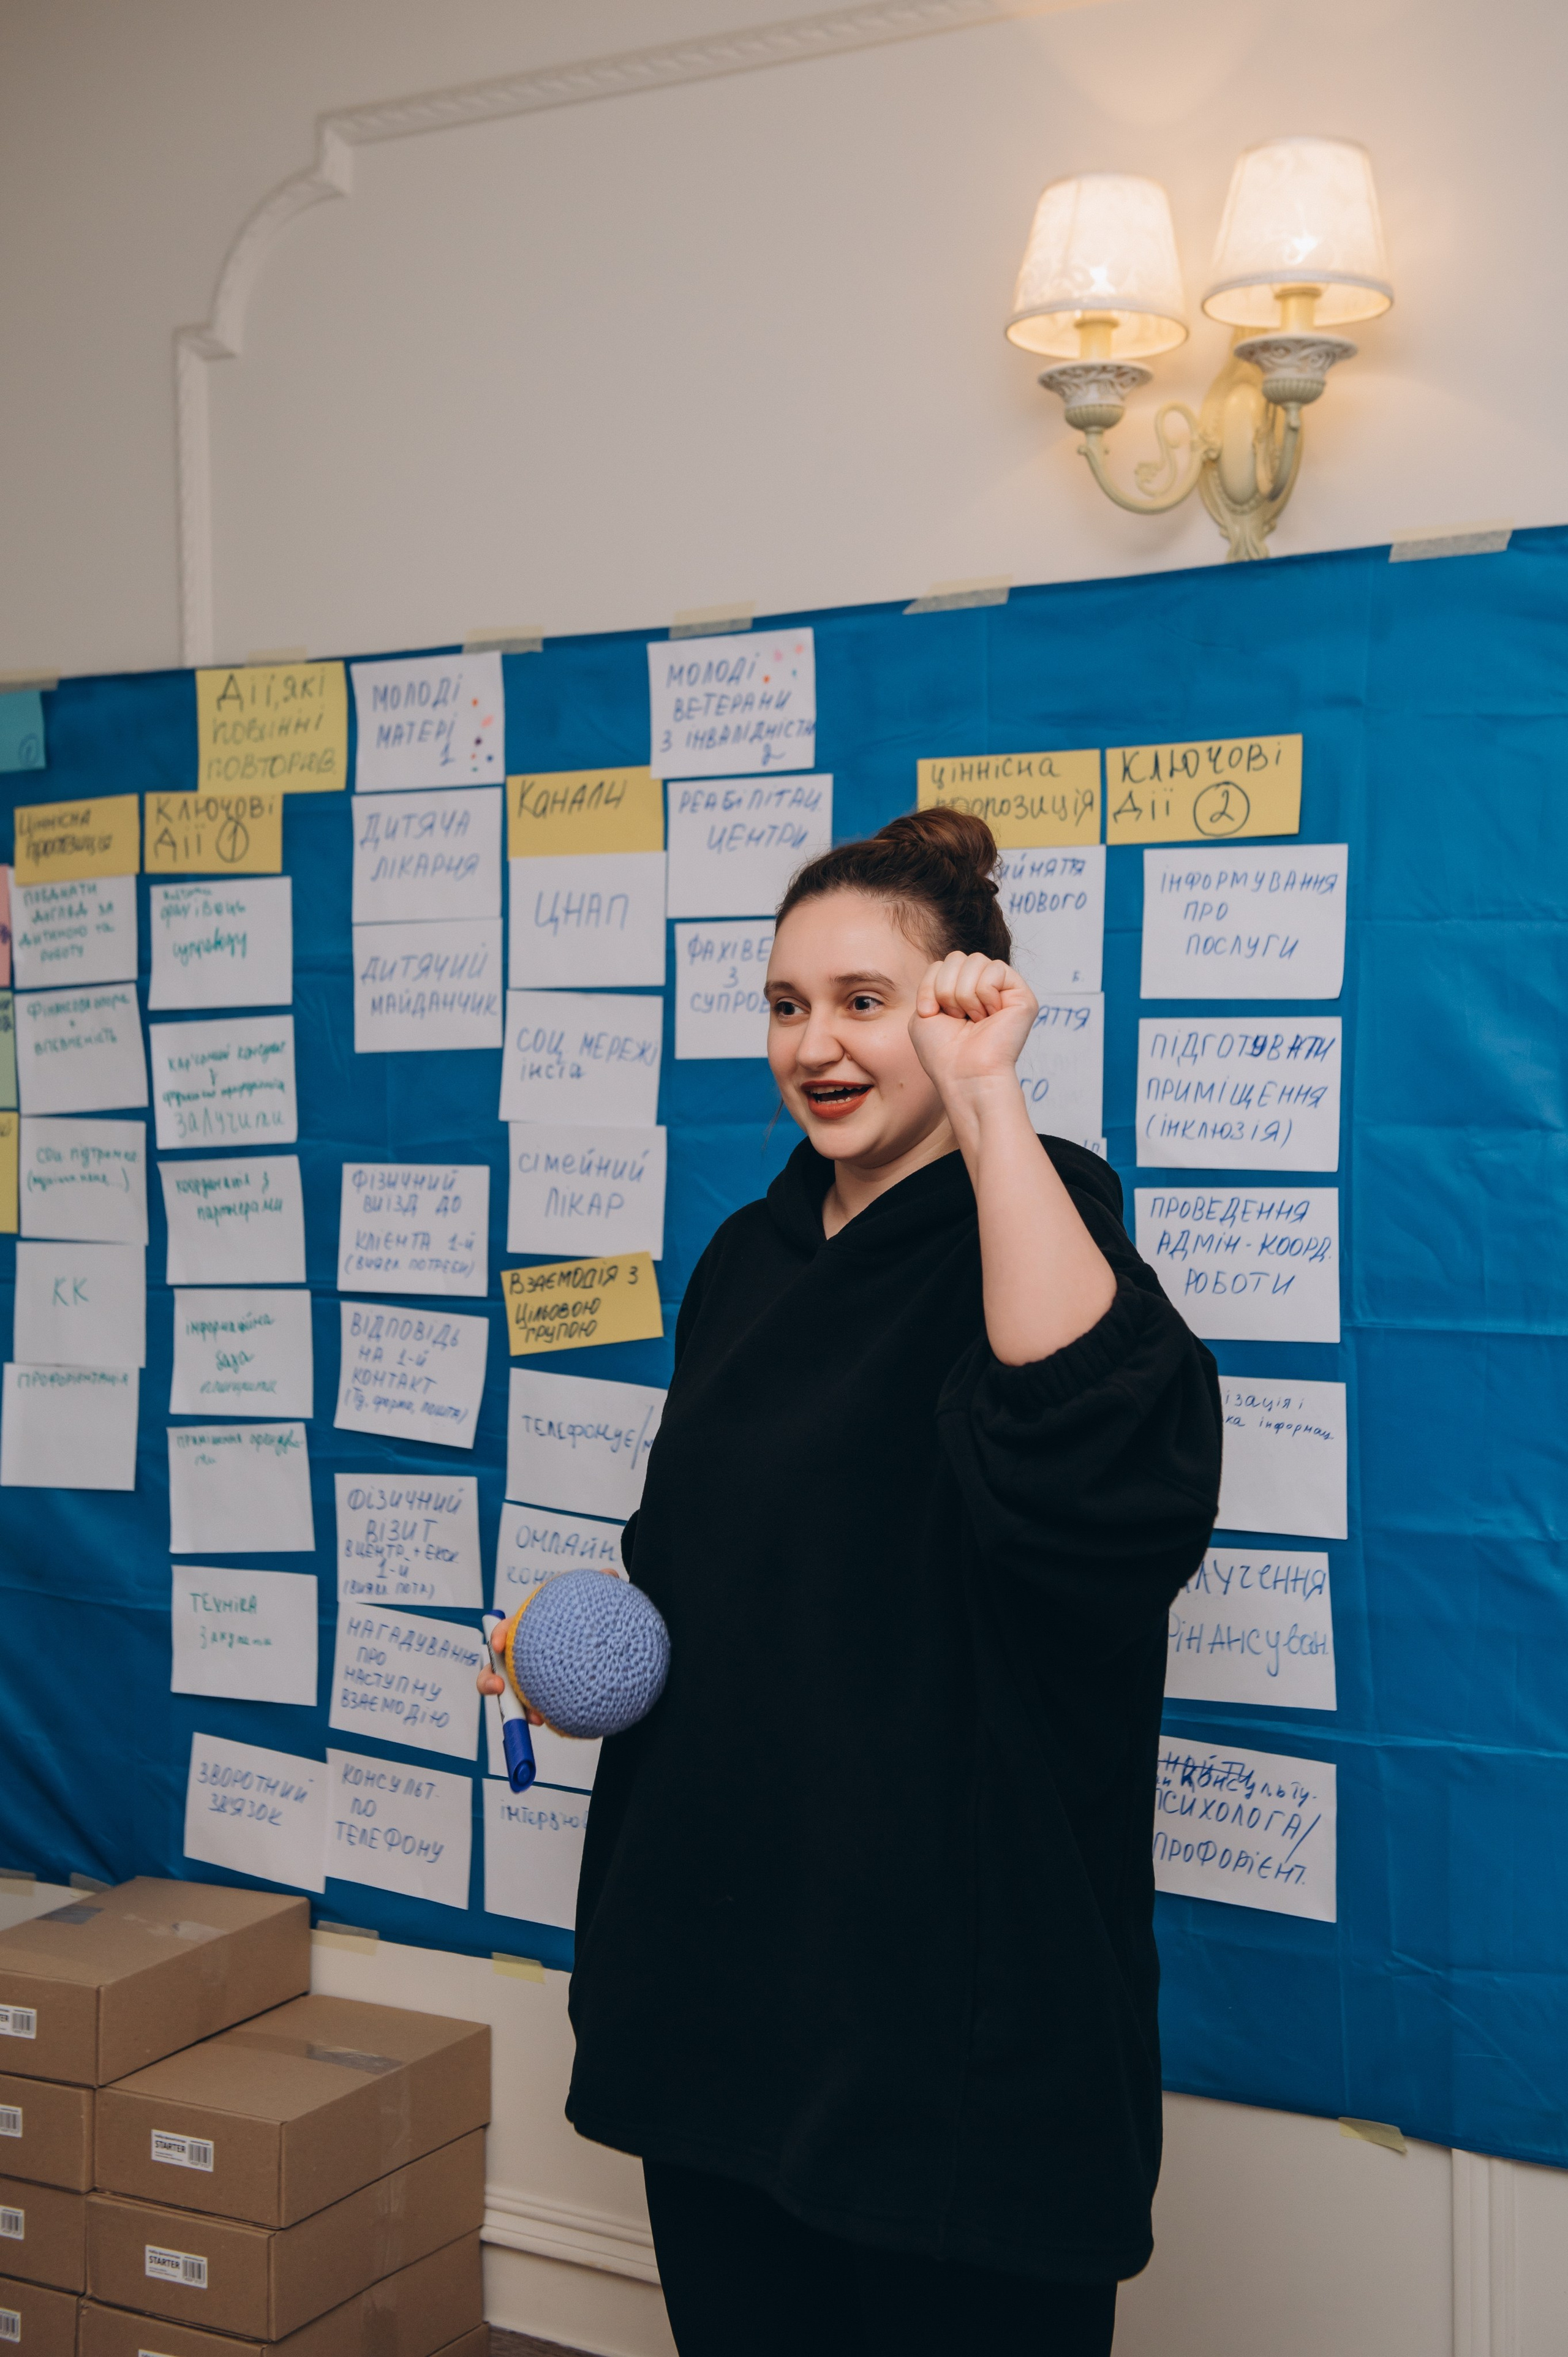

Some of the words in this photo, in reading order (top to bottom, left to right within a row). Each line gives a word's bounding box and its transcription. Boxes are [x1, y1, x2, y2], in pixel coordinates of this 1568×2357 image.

[666, 652, 760, 688] МОЛОДІ
[372, 674, 464, 712] МОЛОДІ
[673, 690, 792, 723] ВЕТЕРАНИ
[375, 711, 456, 749] МАТЕРІ
[1121, 742, 1282, 783] КЛЮЧОВІ
[358, 809, 471, 852] ДИТЯЧА
[706, 822, 809, 854] ЦЕНТРИ
[370, 852, 480, 882] ЛІКАРНЯ
[1160, 864, 1338, 894] ІНФОРМУВАННЯ
[533, 889, 630, 938] ЦНАП
[1009, 890, 1087, 915] НОВОГО
[1183, 900, 1229, 921] ПРО
[687, 932, 775, 967] ФАХІВЕ
[1185, 933, 1300, 960] ПОСЛУГИ
[360, 941, 489, 985] ДИТЯЧИЙ
[369, 987, 499, 1020] МАЙДАНЧИК
[690, 990, 771, 1016] СУПРОВ
[1033, 1005, 1091, 1032] ЯТТЯ
[1146, 1075, 1328, 1111] ПРИМІЩЕННЯ
[1145, 1114, 1293, 1149] (ІНКЛЮЗІЯ)
[351, 1168, 459, 1194] ФІЗИЧНИЙ
[435, 1194, 462, 1218] ДО
[544, 1186, 625, 1219] ЛІКАР
[1150, 1196, 1311, 1229] ПРОВЕДЕННЯ
[355, 1228, 432, 1252] КЛІЄНТА
[1184, 1267, 1297, 1297] РОБОТИ
[349, 1312, 461, 1351] ВІДПОВІДЬ
[525, 1319, 598, 1344] ГРУПОЮ
[358, 1344, 384, 1363] НА
[351, 1366, 438, 1395] КОНТАКТ
[1225, 1389, 1292, 1412] ізація
[1225, 1414, 1246, 1427] ка
[347, 1486, 465, 1515] ФІЗИЧНИЙ
[365, 1518, 439, 1544] ВІЗИТ
[515, 1525, 617, 1563] ОНЛАЙН
[506, 1565, 554, 1585] КОН
[1185, 1559, 1327, 1602] ЛУЧЕННЯ
[189, 1592, 258, 1615] ТЕХНІКА
[346, 1616, 480, 1667] НАГАДУВАННЯ
[355, 1646, 387, 1666] ПРО
[343, 1665, 443, 1702] НАСТУПНУ
[341, 1688, 450, 1729] ВЗАЄМОДІЮ
[197, 1761, 314, 1805] ЗВОРОТНИЙ
[350, 1797, 378, 1818] ПО
[335, 1820, 445, 1863] ТЕЛЕФОНУ
[155, 2140, 186, 2154] STARTER
[148, 2255, 180, 2270] STARTER
